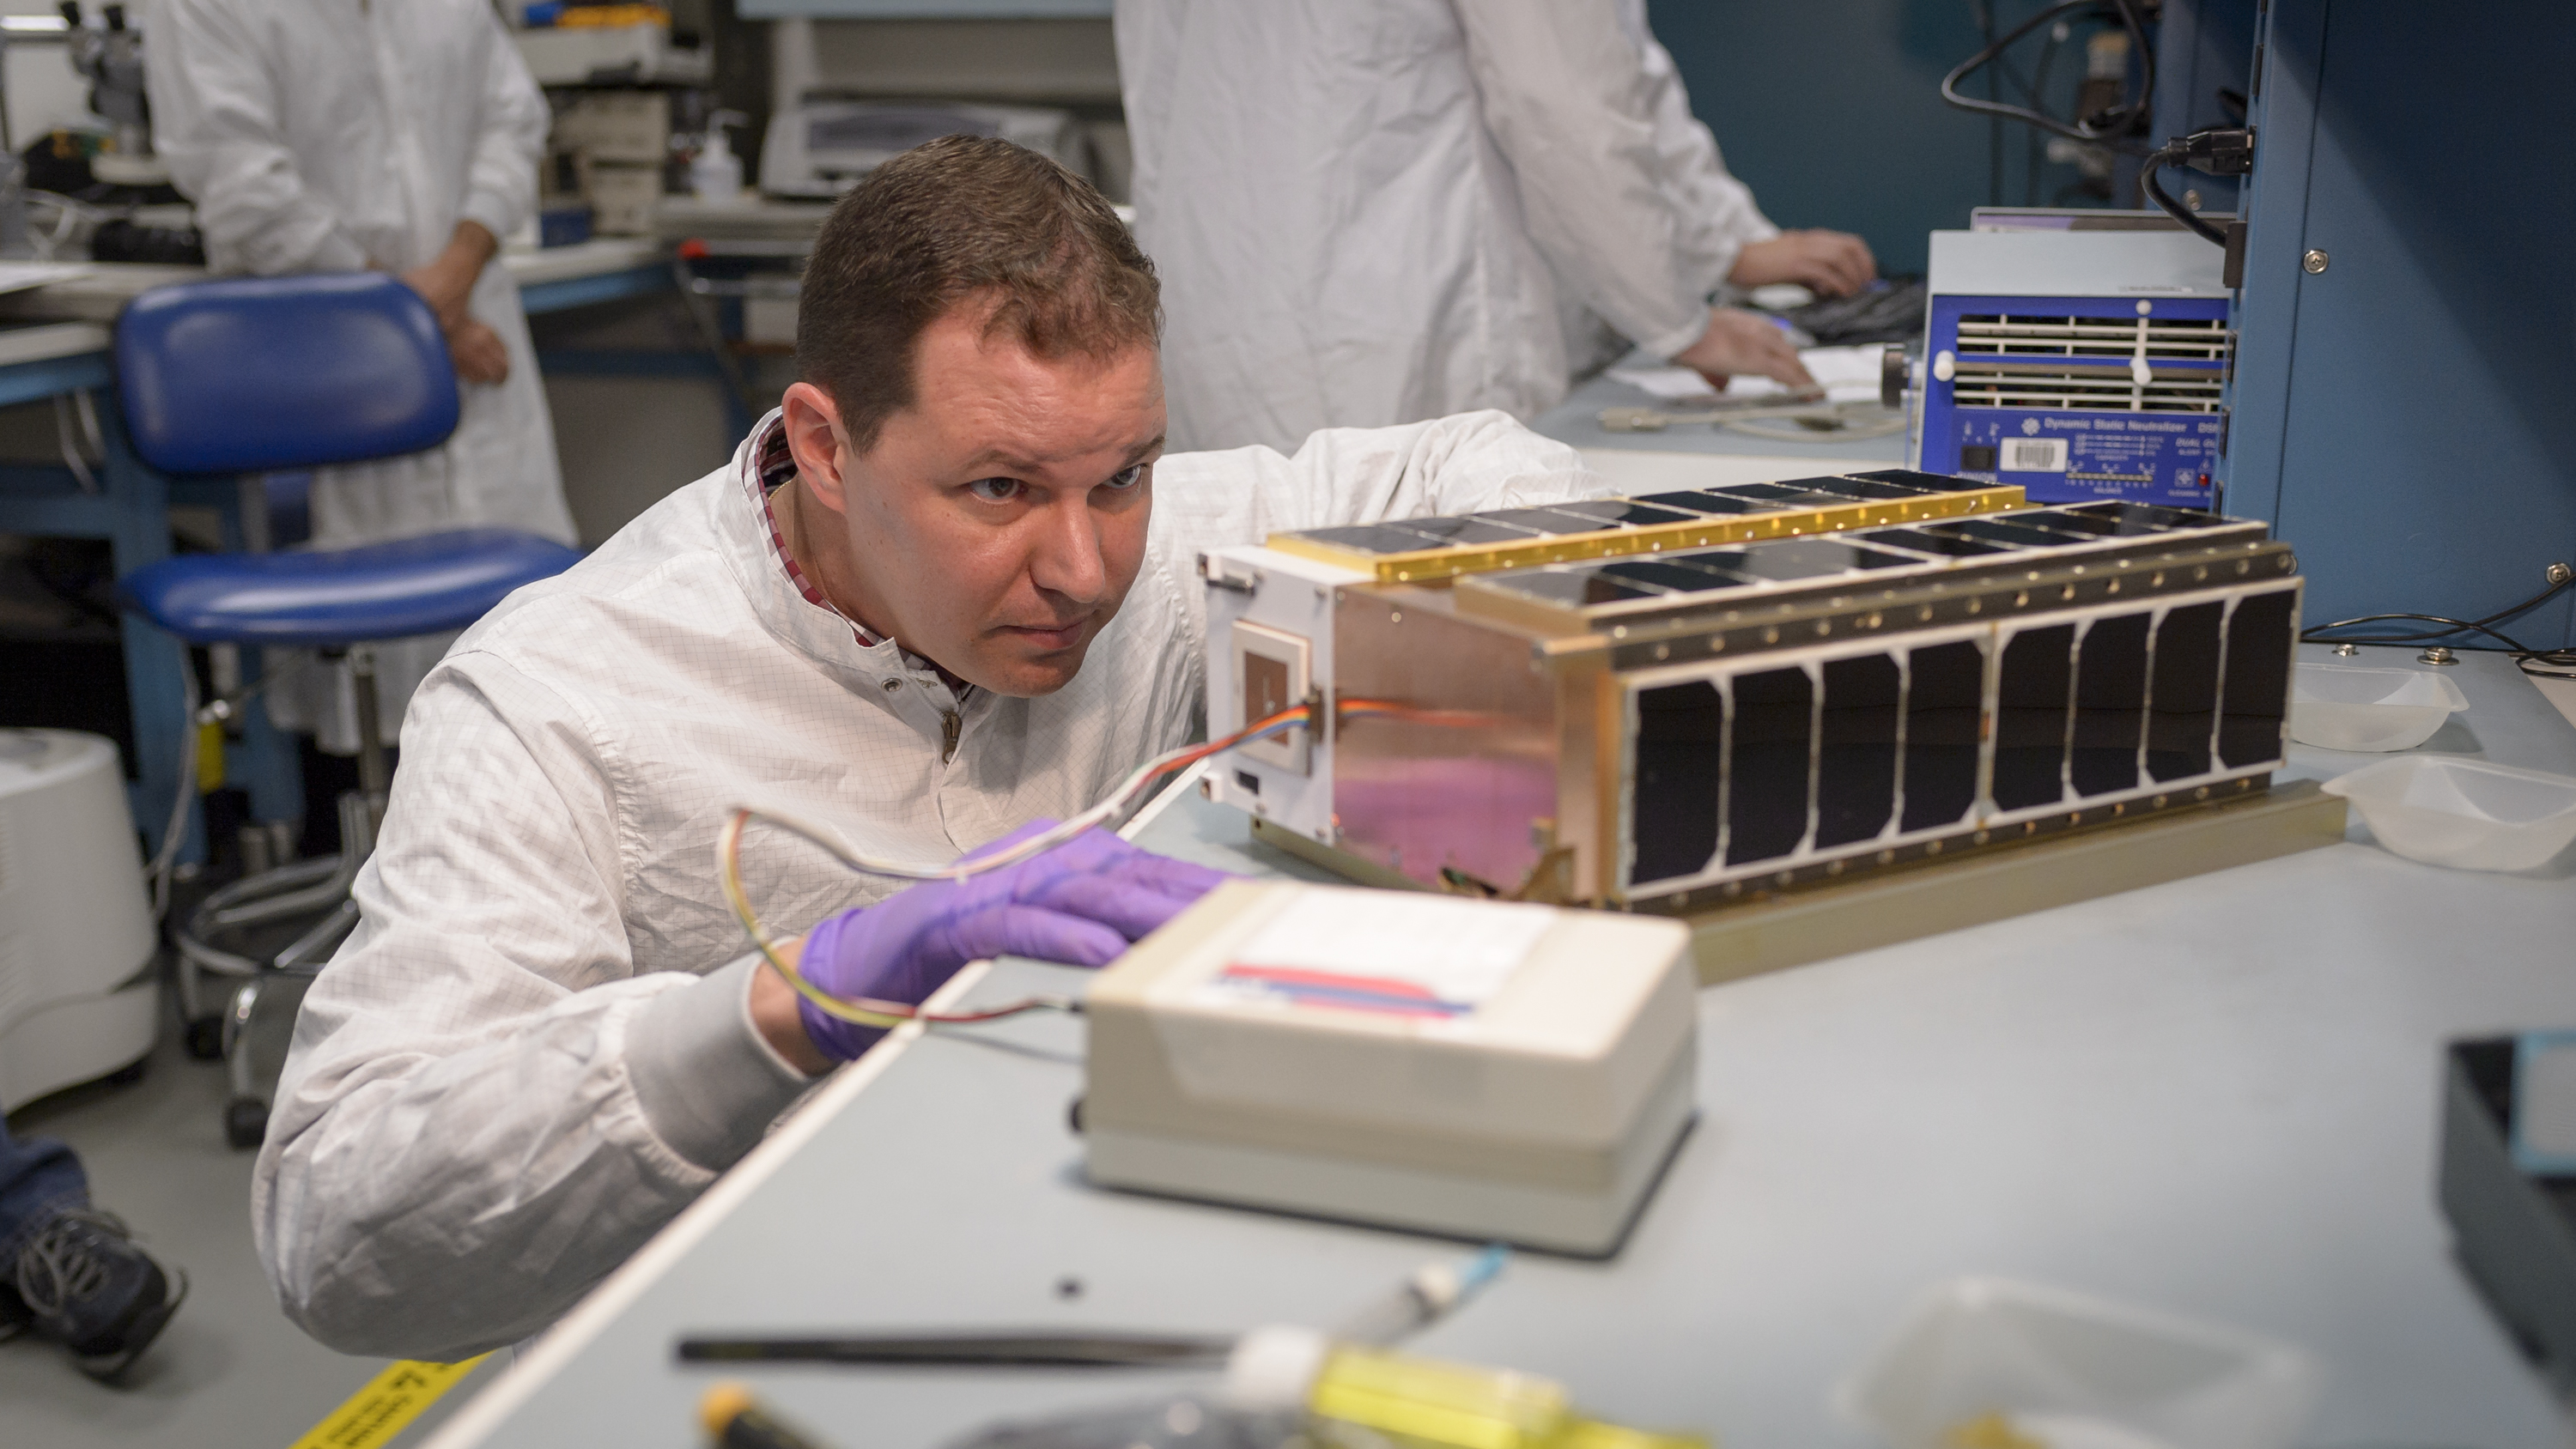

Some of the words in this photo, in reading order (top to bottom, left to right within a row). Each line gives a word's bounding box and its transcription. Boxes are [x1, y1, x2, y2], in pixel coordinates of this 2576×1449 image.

[2044, 417, 2092, 430] Dynamic
[2093, 419, 2125, 431] Static
[2128, 420, 2187, 433] Neutralizer
